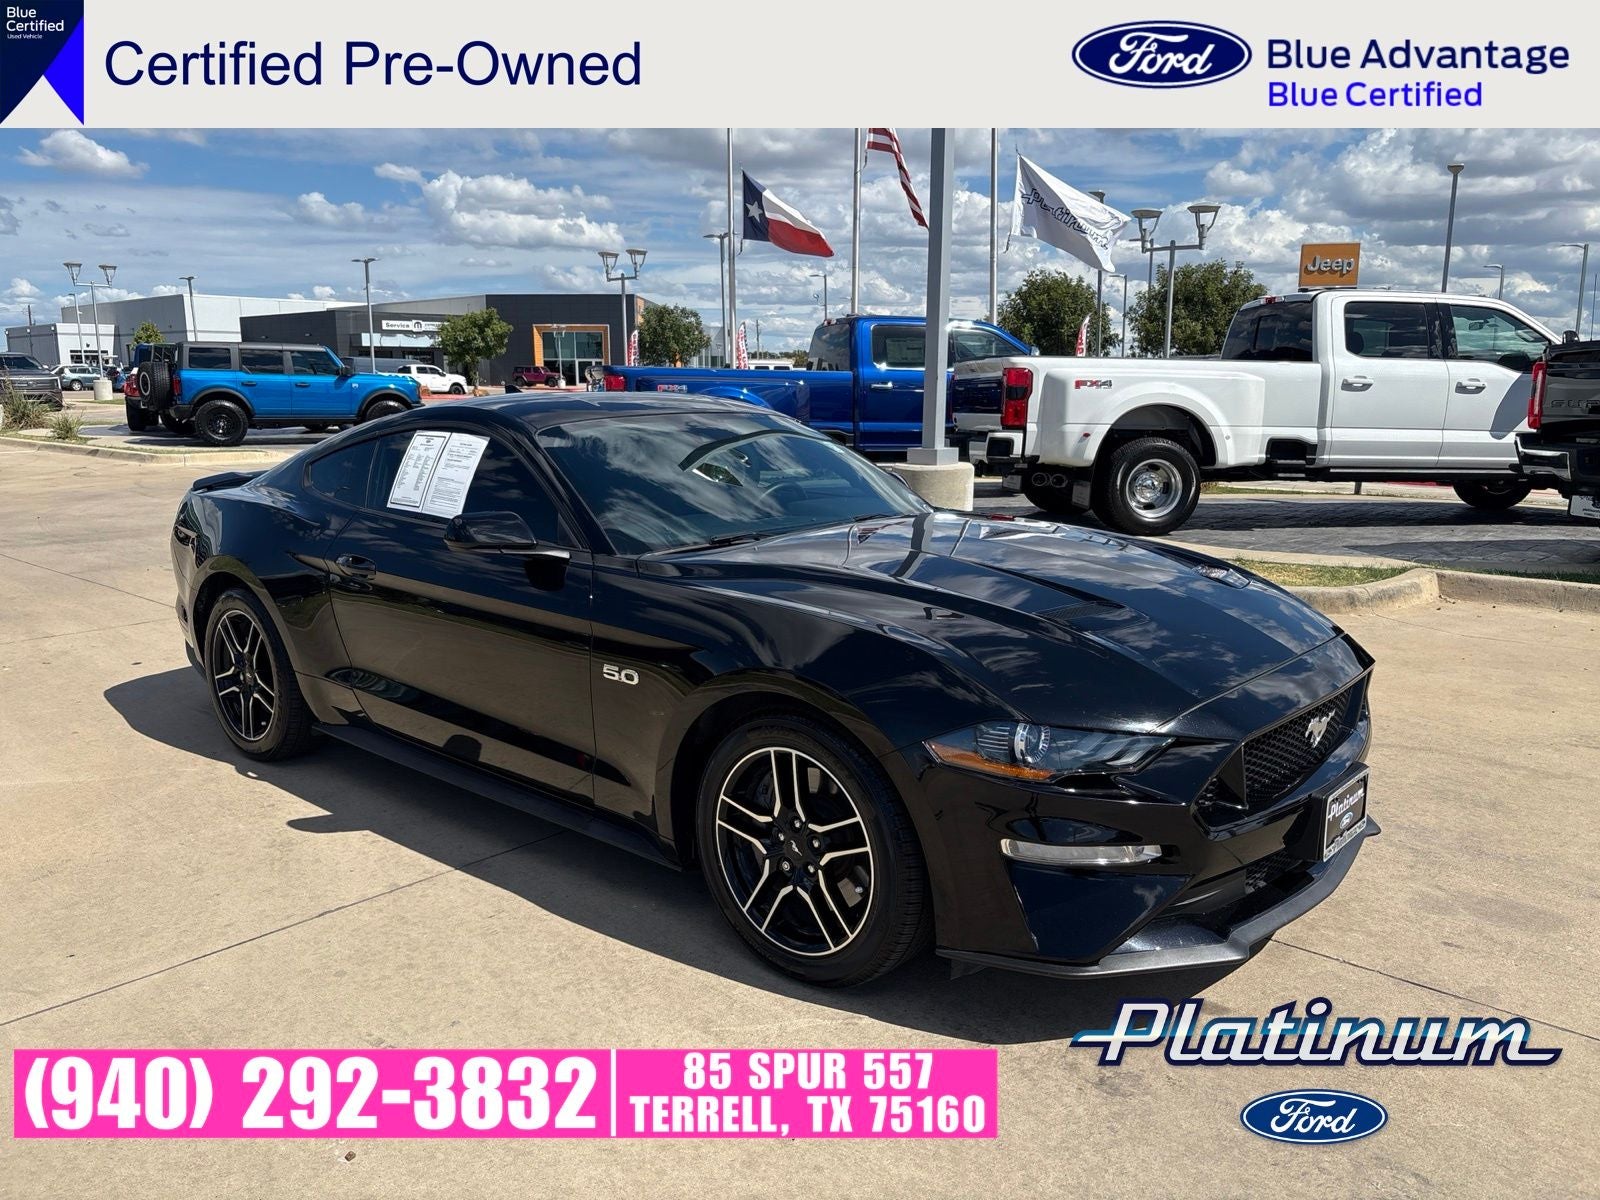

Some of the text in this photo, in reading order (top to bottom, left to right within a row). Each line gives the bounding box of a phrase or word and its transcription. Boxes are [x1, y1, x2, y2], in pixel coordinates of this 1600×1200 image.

[1306, 255, 1355, 275] Jeep
[1074, 379, 1112, 390] FX4
[1327, 787, 1365, 822] Platinum
